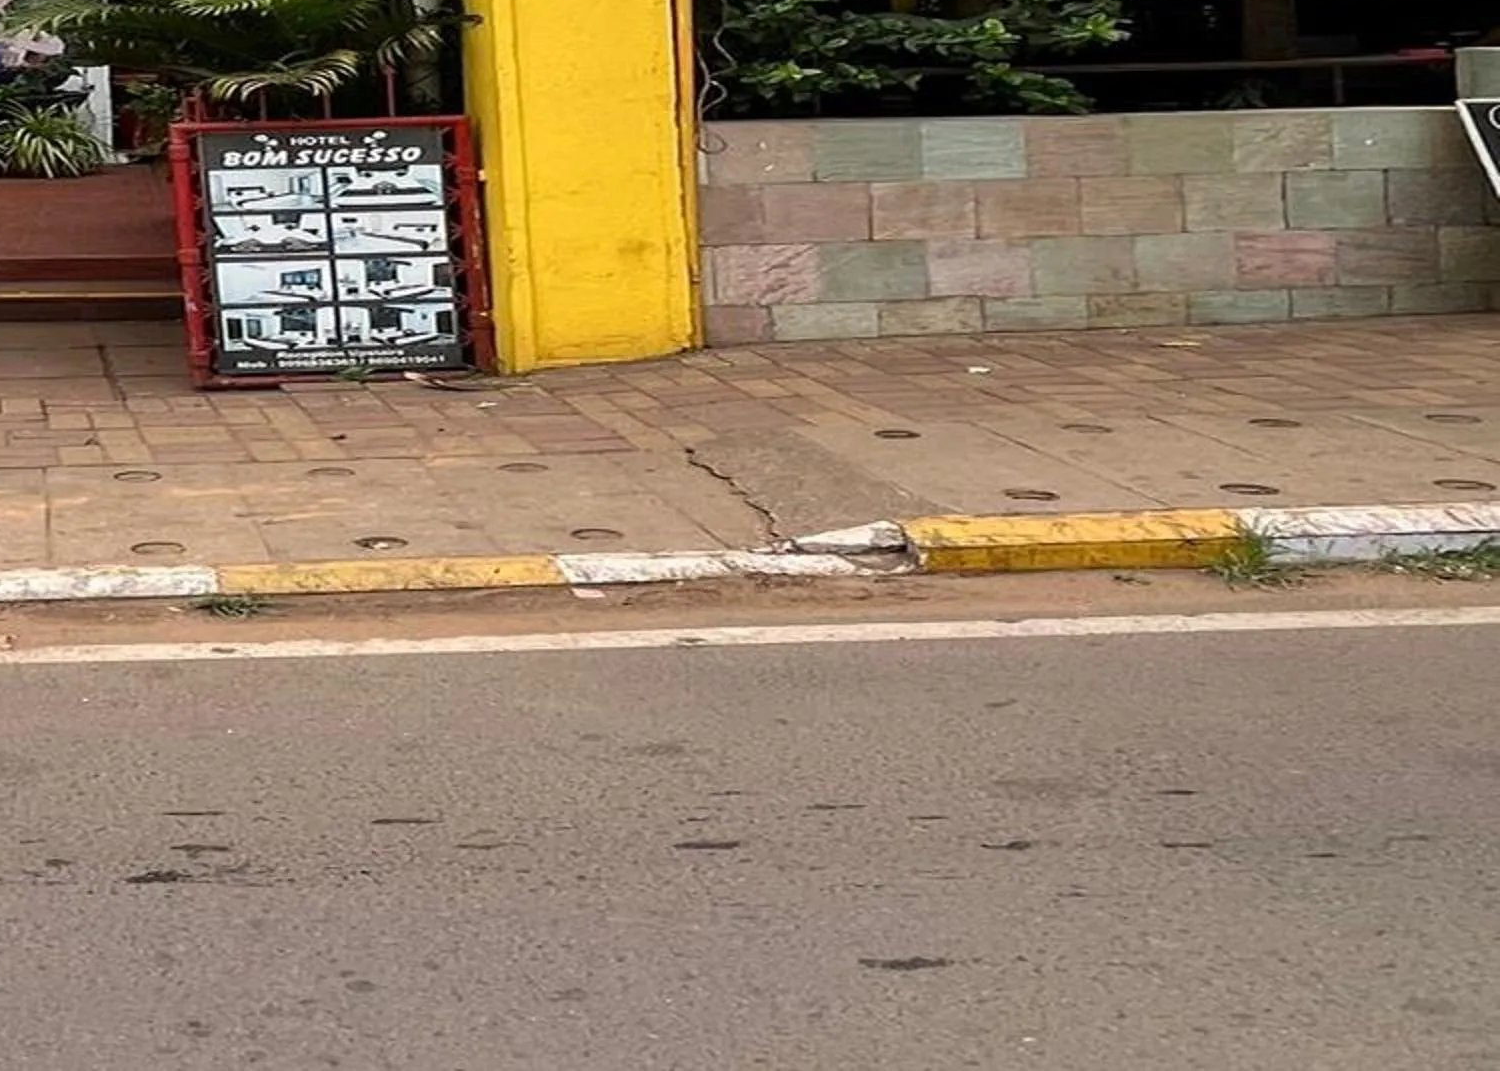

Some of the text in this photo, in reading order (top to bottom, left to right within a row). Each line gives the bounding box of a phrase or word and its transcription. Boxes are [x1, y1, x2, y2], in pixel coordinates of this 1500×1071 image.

[289, 136, 351, 146] HOTEL
[223, 146, 422, 167] BOM SUCESSO
